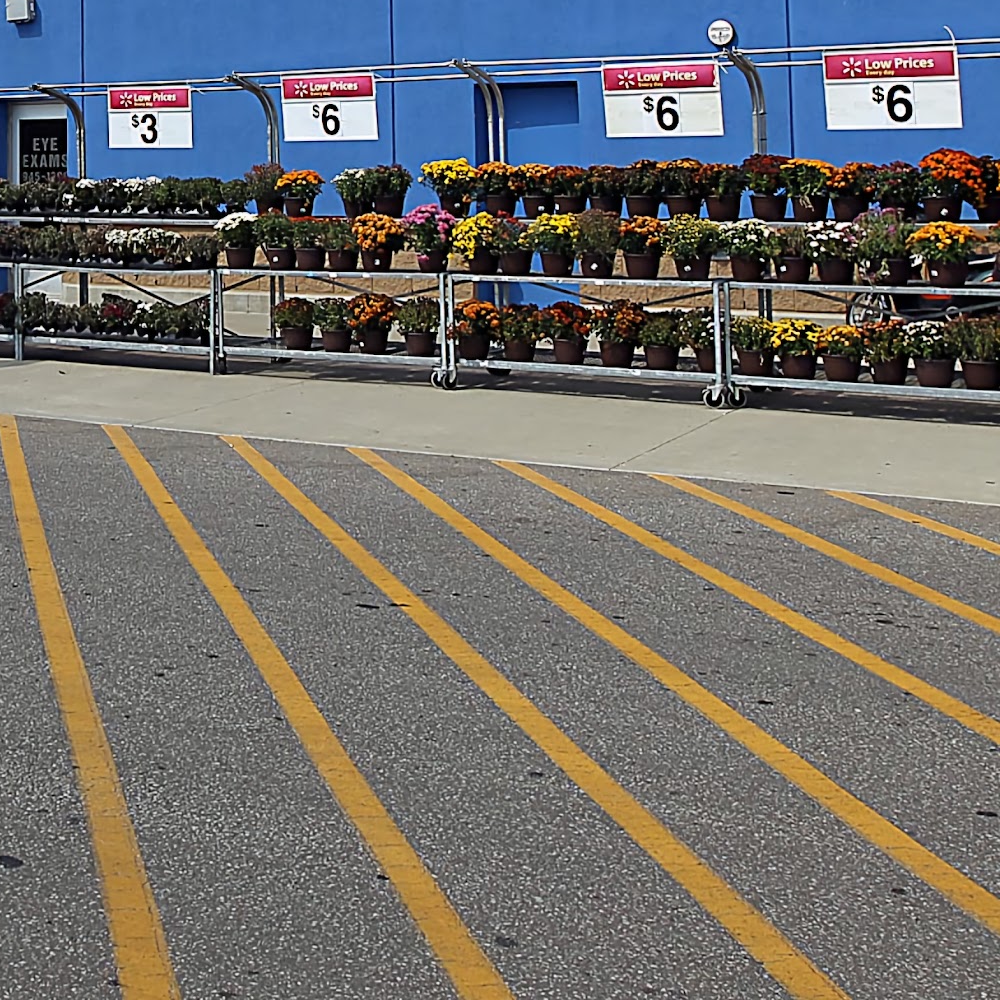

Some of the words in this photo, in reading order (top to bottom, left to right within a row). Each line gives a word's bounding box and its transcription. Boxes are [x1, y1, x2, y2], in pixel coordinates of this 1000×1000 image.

[864, 58, 892, 70] Low
[894, 56, 935, 69] Prices
[637, 71, 660, 82] Low
[662, 70, 697, 81] Prices
[309, 82, 329, 92] Low
[330, 81, 358, 91] Prices
[133, 93, 152, 102] Low
[152, 92, 176, 102] Prices
[33, 137, 58, 151] EYE
[22, 154, 67, 168] EXAMS
